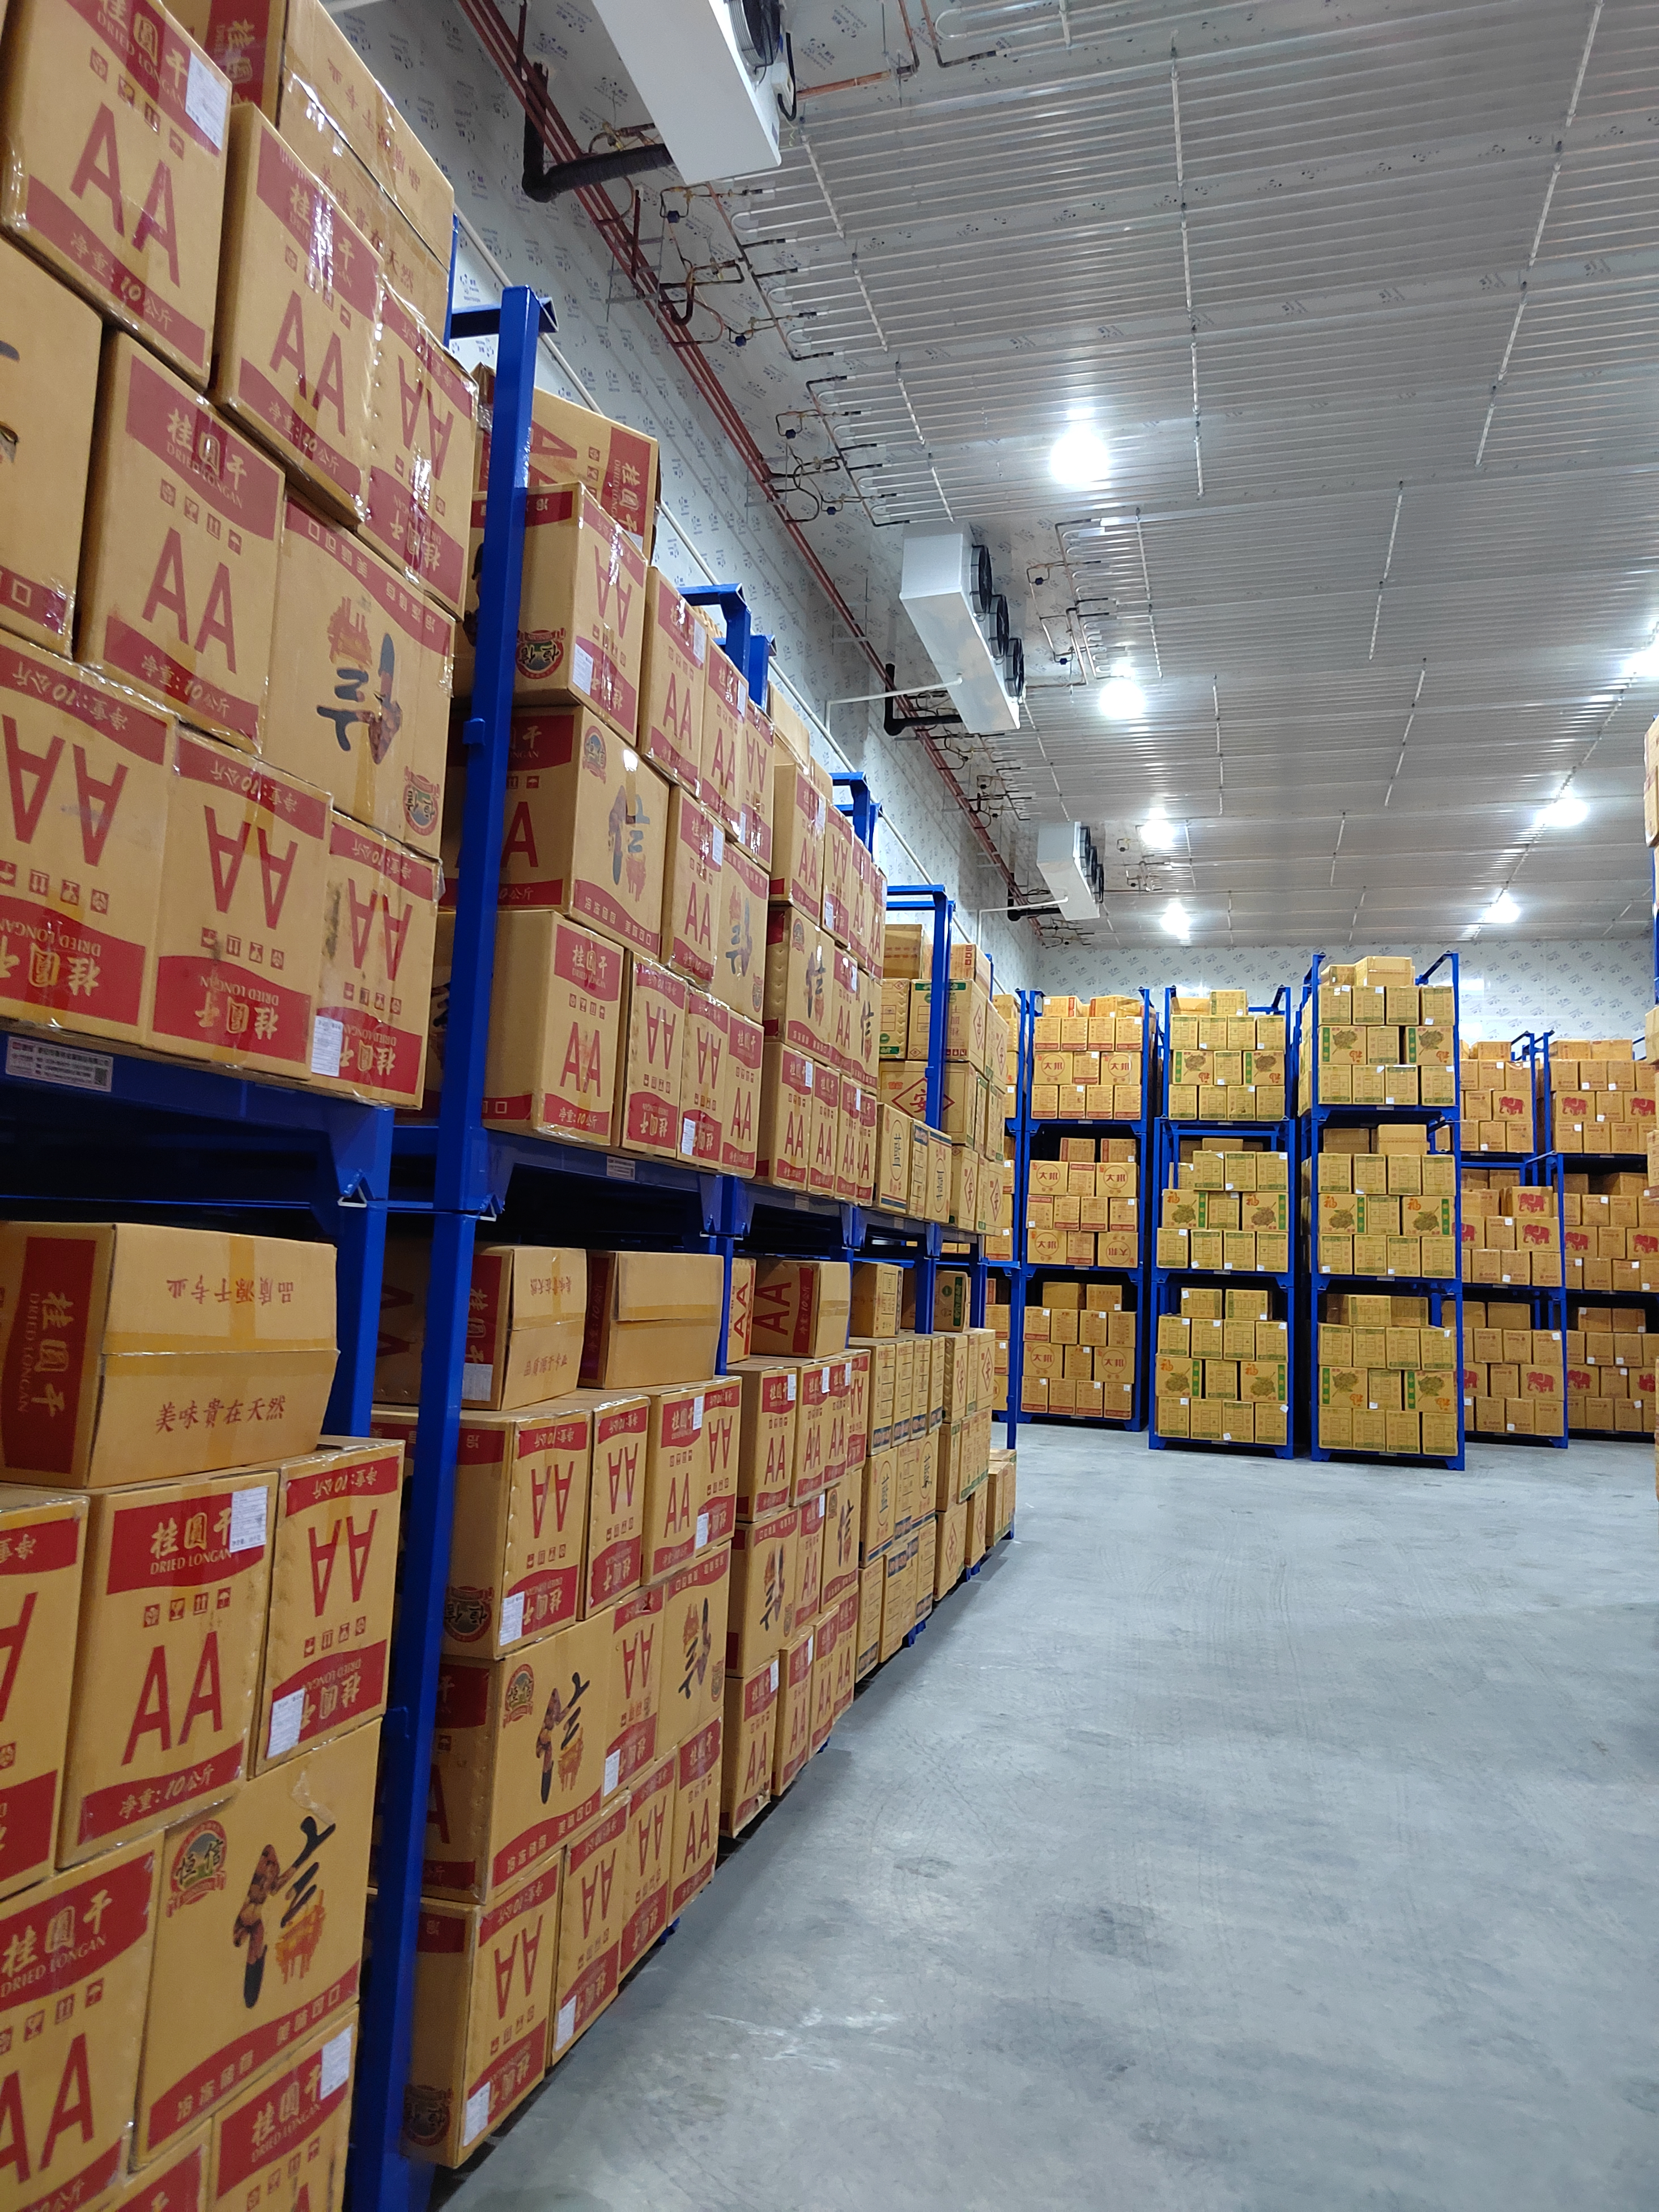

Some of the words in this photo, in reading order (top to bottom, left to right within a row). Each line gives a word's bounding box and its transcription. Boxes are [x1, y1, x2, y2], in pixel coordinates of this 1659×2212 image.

[97, 10, 135, 56] DRIED
[70, 102, 181, 288] AA
[269, 290, 346, 438] AA
[167, 408, 248, 491] 桂圓干
[398, 354, 454, 481] AA
[141, 527, 237, 674] AA
[594, 544, 633, 639] AA
[663, 672, 693, 751] AA
[1, 713, 129, 868] AA
[711, 728, 736, 798] AA
[745, 729, 767, 793] AA
[203, 805, 299, 931] AA
[798, 837, 817, 893] AA
[831, 833, 849, 884] AA
[59, 935, 101, 958] DRIED
[347, 877, 414, 982] AA
[684, 881, 712, 951] AA
[199, 975, 245, 999] LONGAN
[572, 944, 608, 980] 桂圓干
[195, 1001, 280, 1042] 桂圓干
[249, 988, 280, 1007] DRIED
[835, 1005, 850, 1050] AA
[559, 1020, 602, 1099] AA
[645, 1000, 677, 1071] AA
[696, 1027, 722, 1090] AA
[730, 1087, 752, 1142] AA
[784, 1111, 804, 1159] AA
[815, 1122, 832, 1167] AA
[842, 1133, 854, 1175] AA
[733, 1282, 749, 1339] AA
[751, 1282, 792, 1336] AA
[31, 1291, 74, 1417] 桂圓干
[155, 1394, 287, 1435] 美味貴在天然
[850, 1376, 865, 1418] AA
[708, 1415, 733, 1474] AA
[764, 1435, 785, 1486] AA
[803, 1424, 821, 1472] AA
[829, 1415, 845, 1460] AA
[530, 1461, 575, 1539] AA
[607, 1443, 639, 1515] AA
[664, 1472, 690, 1539] AA
[150, 1556, 186, 1575] DRIED
[188, 1547, 232, 1567] LONGAN
[307, 1508, 378, 1619] AA
[801, 1551, 818, 1601] AA
[623, 1623, 655, 1700] AA
[836, 1646, 850, 1695] AA
[121, 1630, 224, 1767] AA
[789, 1698, 807, 1755] AA
[818, 1671, 832, 1724] AA
[744, 1730, 768, 1794] AA
[638, 1794, 667, 1877] AA
[682, 1798, 711, 1874] AA
[581, 1848, 616, 1941] AA
[1, 1888, 113, 1978] 桂圓干
[49, 1934, 107, 1974] LONGAN
[494, 1914, 543, 2021] AA
[0, 2032, 95, 2184] AA
